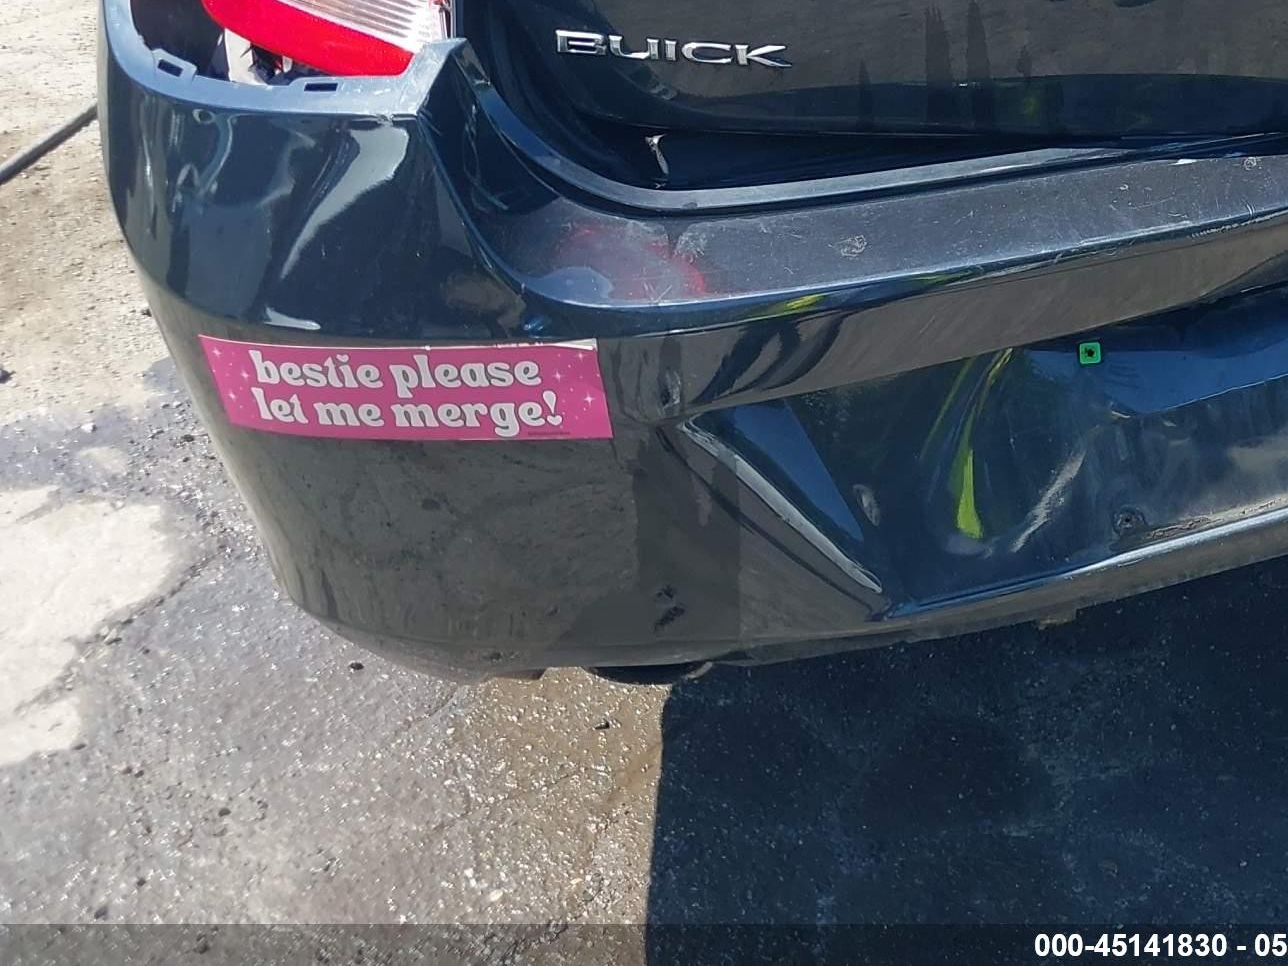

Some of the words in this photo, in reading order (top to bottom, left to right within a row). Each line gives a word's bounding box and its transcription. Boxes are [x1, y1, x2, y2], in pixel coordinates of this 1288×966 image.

[555, 29, 793, 68] BUICK
[248, 349, 384, 389] bestie
[389, 354, 542, 399] please
[250, 386, 309, 425] let
[313, 400, 385, 428] me
[389, 389, 564, 439] merge!
